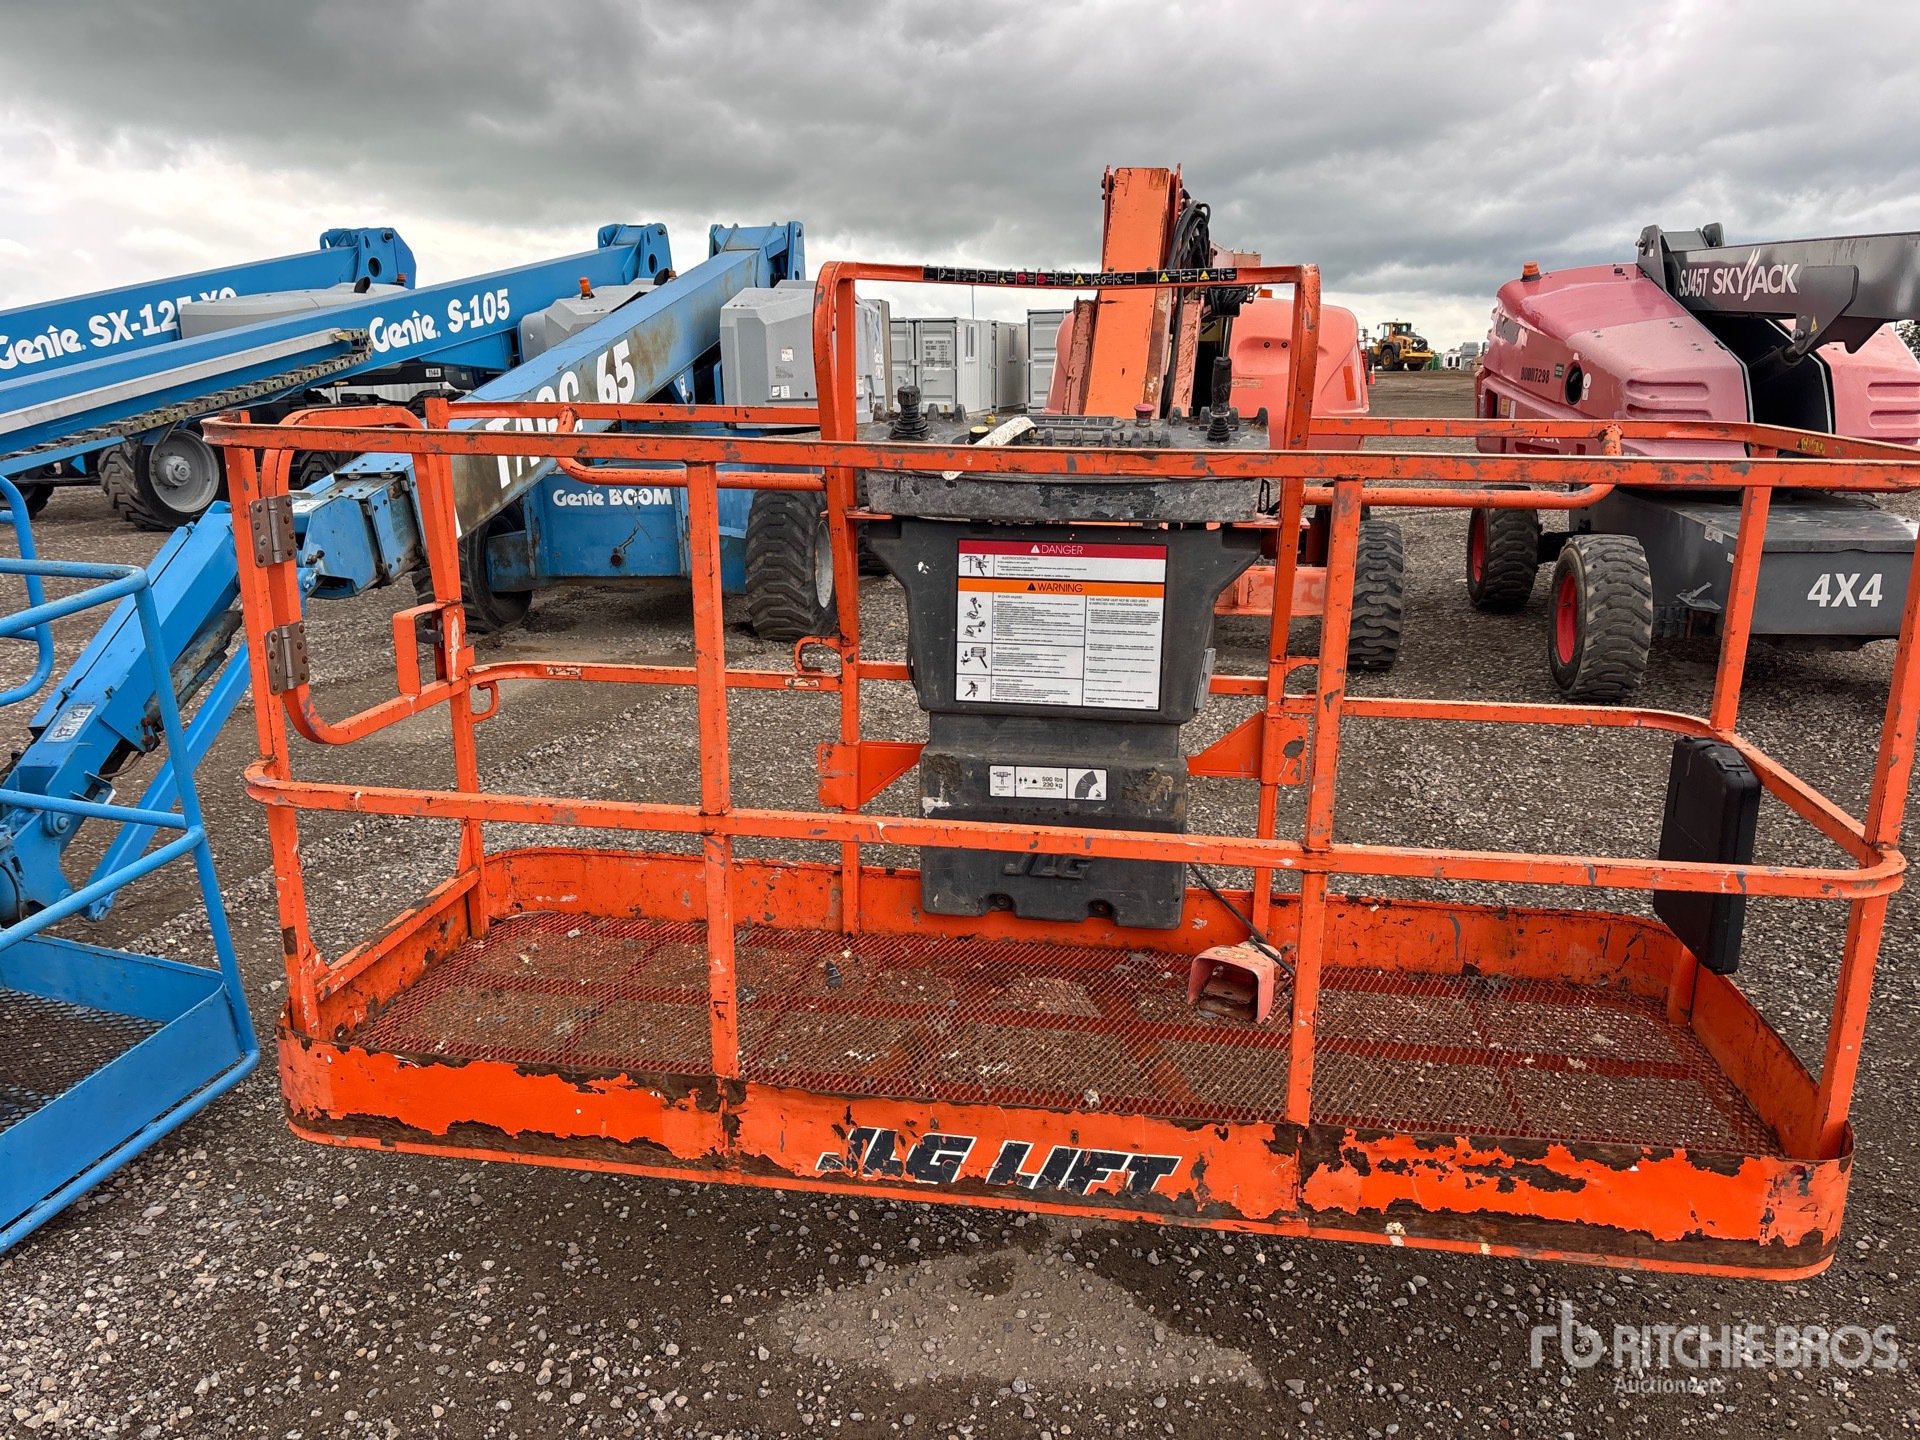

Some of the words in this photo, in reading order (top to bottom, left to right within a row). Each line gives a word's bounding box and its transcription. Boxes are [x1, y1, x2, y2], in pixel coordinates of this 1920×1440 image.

[1679, 267, 1709, 297] SJ45T
[1712, 248, 1799, 301] SKYJACK
[0, 324, 83, 369] Genie
[88, 295, 191, 347] SX-12
[369, 310, 437, 353] Genie
[447, 288, 511, 333] S-105
[596, 339, 636, 403] 65
[552, 489, 604, 507] Genie
[609, 488, 673, 506] BOOM
[1041, 545, 1084, 555] DANGER
[1037, 582, 1084, 593] WARNING
[1807, 573, 1883, 607] 4X4
[815, 1126, 977, 1184] JLG
[985, 1140, 1183, 1196] LIFT
